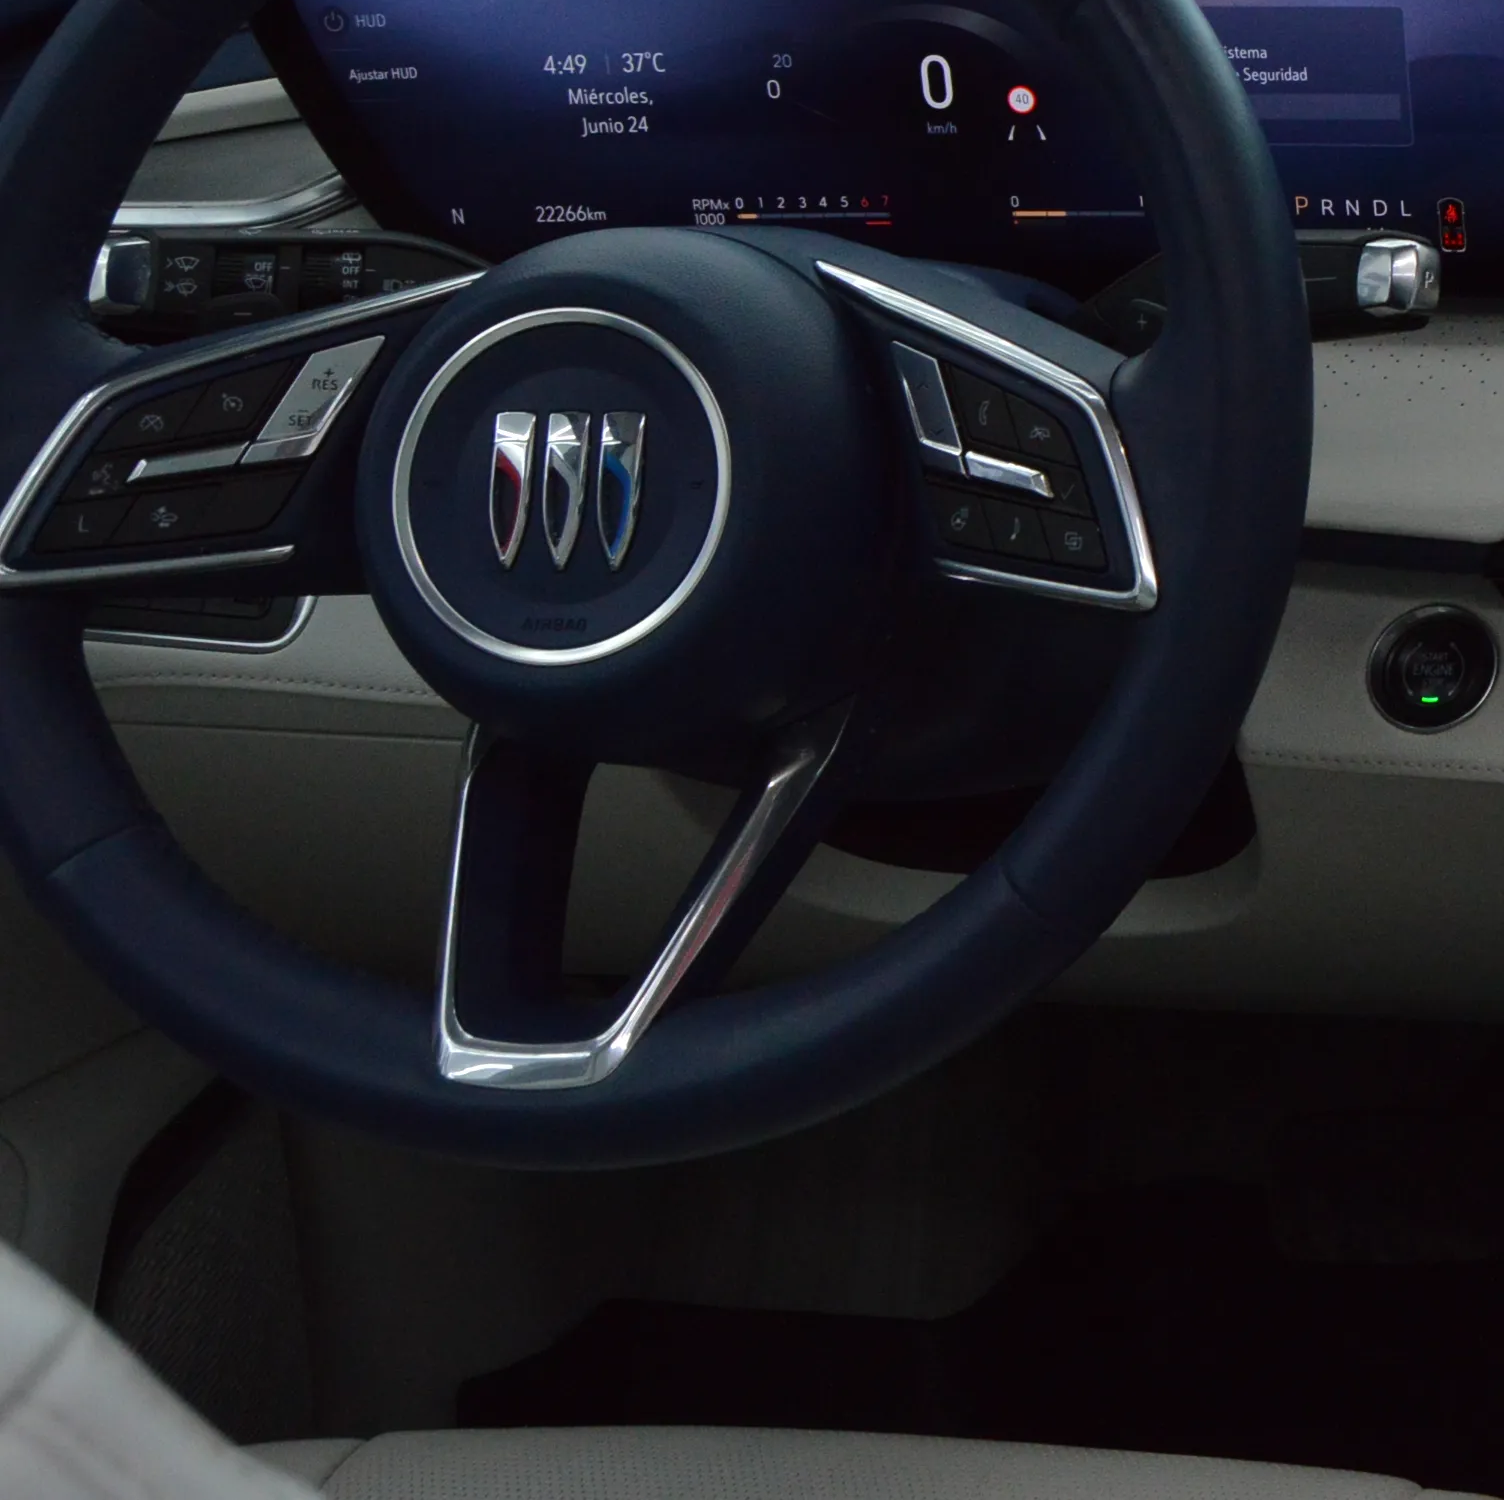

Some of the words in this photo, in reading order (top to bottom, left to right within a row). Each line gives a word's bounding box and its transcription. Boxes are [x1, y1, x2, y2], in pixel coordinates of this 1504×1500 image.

[354, 13, 386, 29] HUD
[542, 53, 587, 75] 4:49
[620, 51, 667, 74] 37°C
[772, 53, 793, 69] 20
[348, 68, 389, 84] Ajustar
[390, 66, 418, 81] HUD
[919, 53, 954, 110] 0
[1243, 66, 1308, 85] Seguridad
[567, 85, 654, 107] Miércoles,
[766, 79, 781, 100] 0
[1014, 92, 1030, 106] 40
[580, 116, 625, 138] Junio
[626, 115, 649, 133] 24
[926, 121, 958, 135] km/h
[692, 198, 731, 211] RPMx
[734, 197, 744, 210] 0
[757, 197, 764, 210] 1
[776, 197, 786, 210] 2
[797, 197, 807, 209] 3
[818, 197, 828, 209] 4
[839, 196, 849, 209] 5
[860, 196, 869, 208] 6
[881, 195, 889, 207] 7
[1009, 195, 1020, 209] 0
[1293, 195, 1309, 216] P
[1320, 198, 1335, 217] R
[1345, 198, 1360, 217] N
[1373, 198, 1388, 217] D
[1400, 199, 1412, 218] L
[450, 206, 466, 226] N
[534, 204, 608, 223] 22266km
[694, 212, 725, 226] 1000
[253, 261, 273, 272] OFF
[342, 265, 360, 276] OFF
[311, 379, 338, 391] RES
[288, 415, 313, 427] SET
[519, 616, 588, 633] AIRBAG
